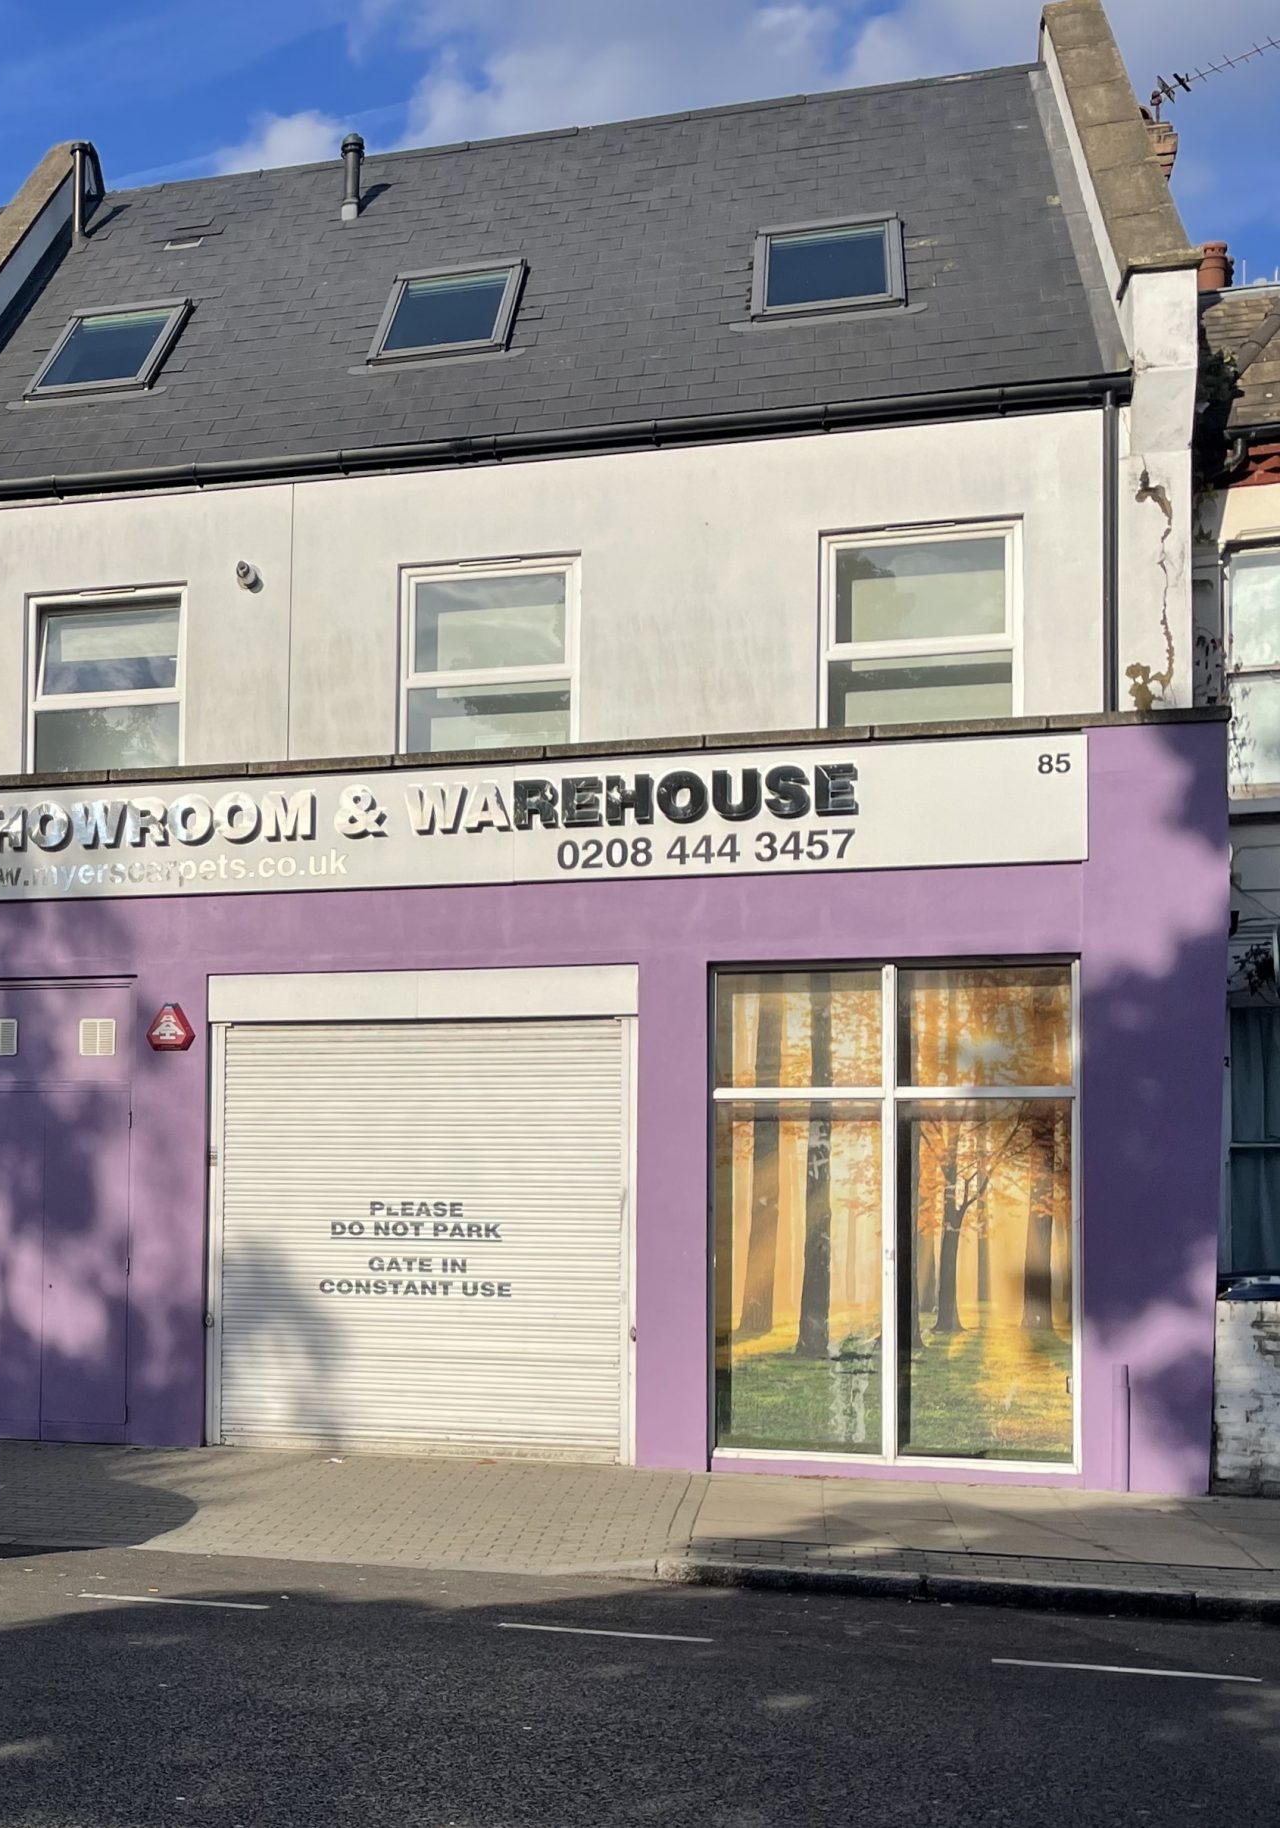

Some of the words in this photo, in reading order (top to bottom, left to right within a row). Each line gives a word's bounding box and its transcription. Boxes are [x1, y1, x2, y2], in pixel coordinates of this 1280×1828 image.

[1037, 752, 1072, 776] 85
[333, 783, 388, 837] &
[405, 762, 860, 838] WAREHOUSE
[557, 837, 653, 872] 0208
[666, 832, 741, 867] 444
[754, 828, 857, 864] 3457
[369, 1200, 465, 1218] PLEASE
[330, 1221, 365, 1238] DO
[373, 1221, 425, 1238] NOT
[433, 1221, 503, 1240] PARK
[368, 1256, 434, 1274] GATE
[441, 1257, 468, 1274] IN
[319, 1278, 454, 1297] CONSTANT
[462, 1281, 513, 1298] USE
